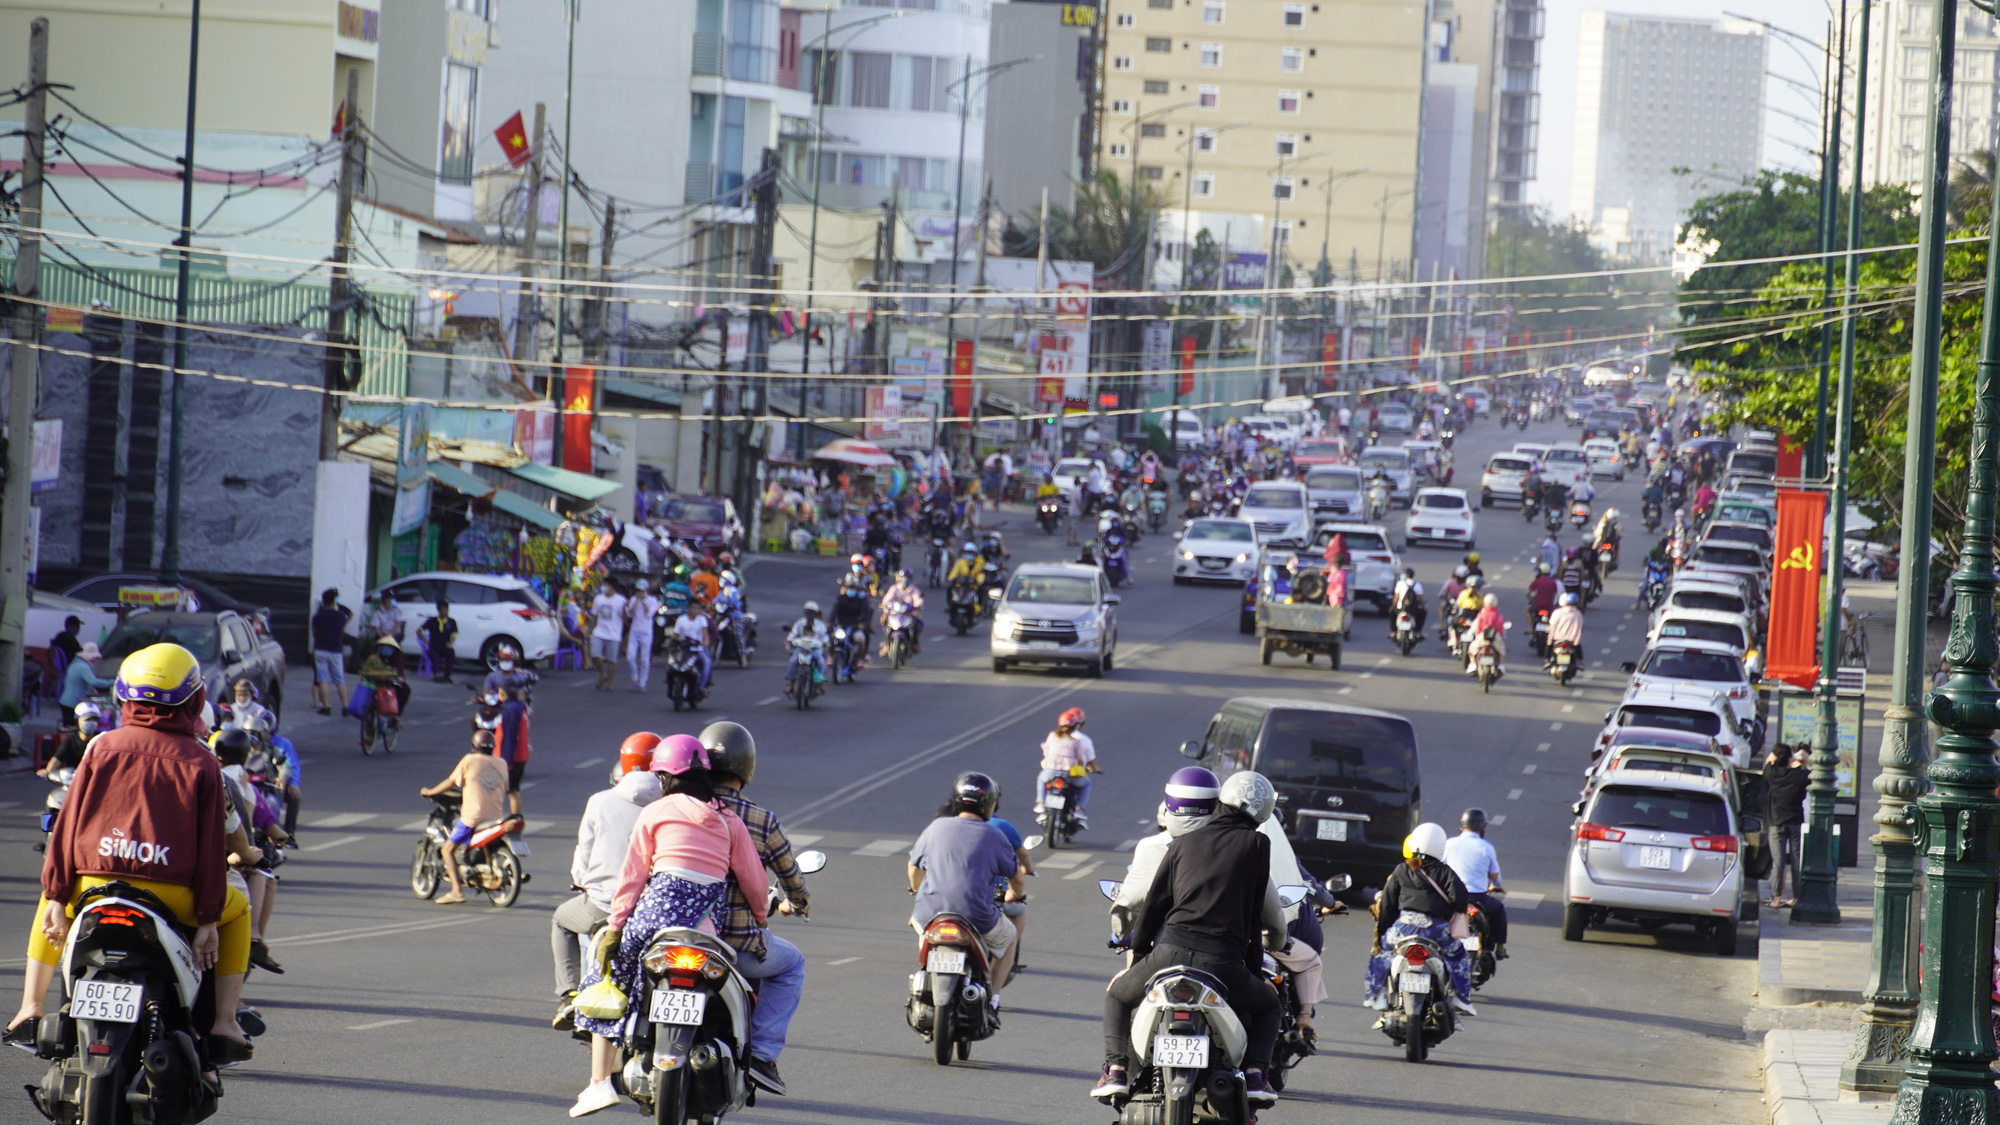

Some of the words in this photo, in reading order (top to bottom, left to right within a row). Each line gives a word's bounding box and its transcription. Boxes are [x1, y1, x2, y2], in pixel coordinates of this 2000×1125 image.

[86, 983, 131, 1002] 60-C2
[661, 992, 697, 1008] 72-E1
[76, 1000, 135, 1019] 755.90
[653, 1007, 700, 1023] 497.02
[1163, 1038, 1201, 1051] 59-P2
[1157, 1051, 1203, 1065] 432.71
